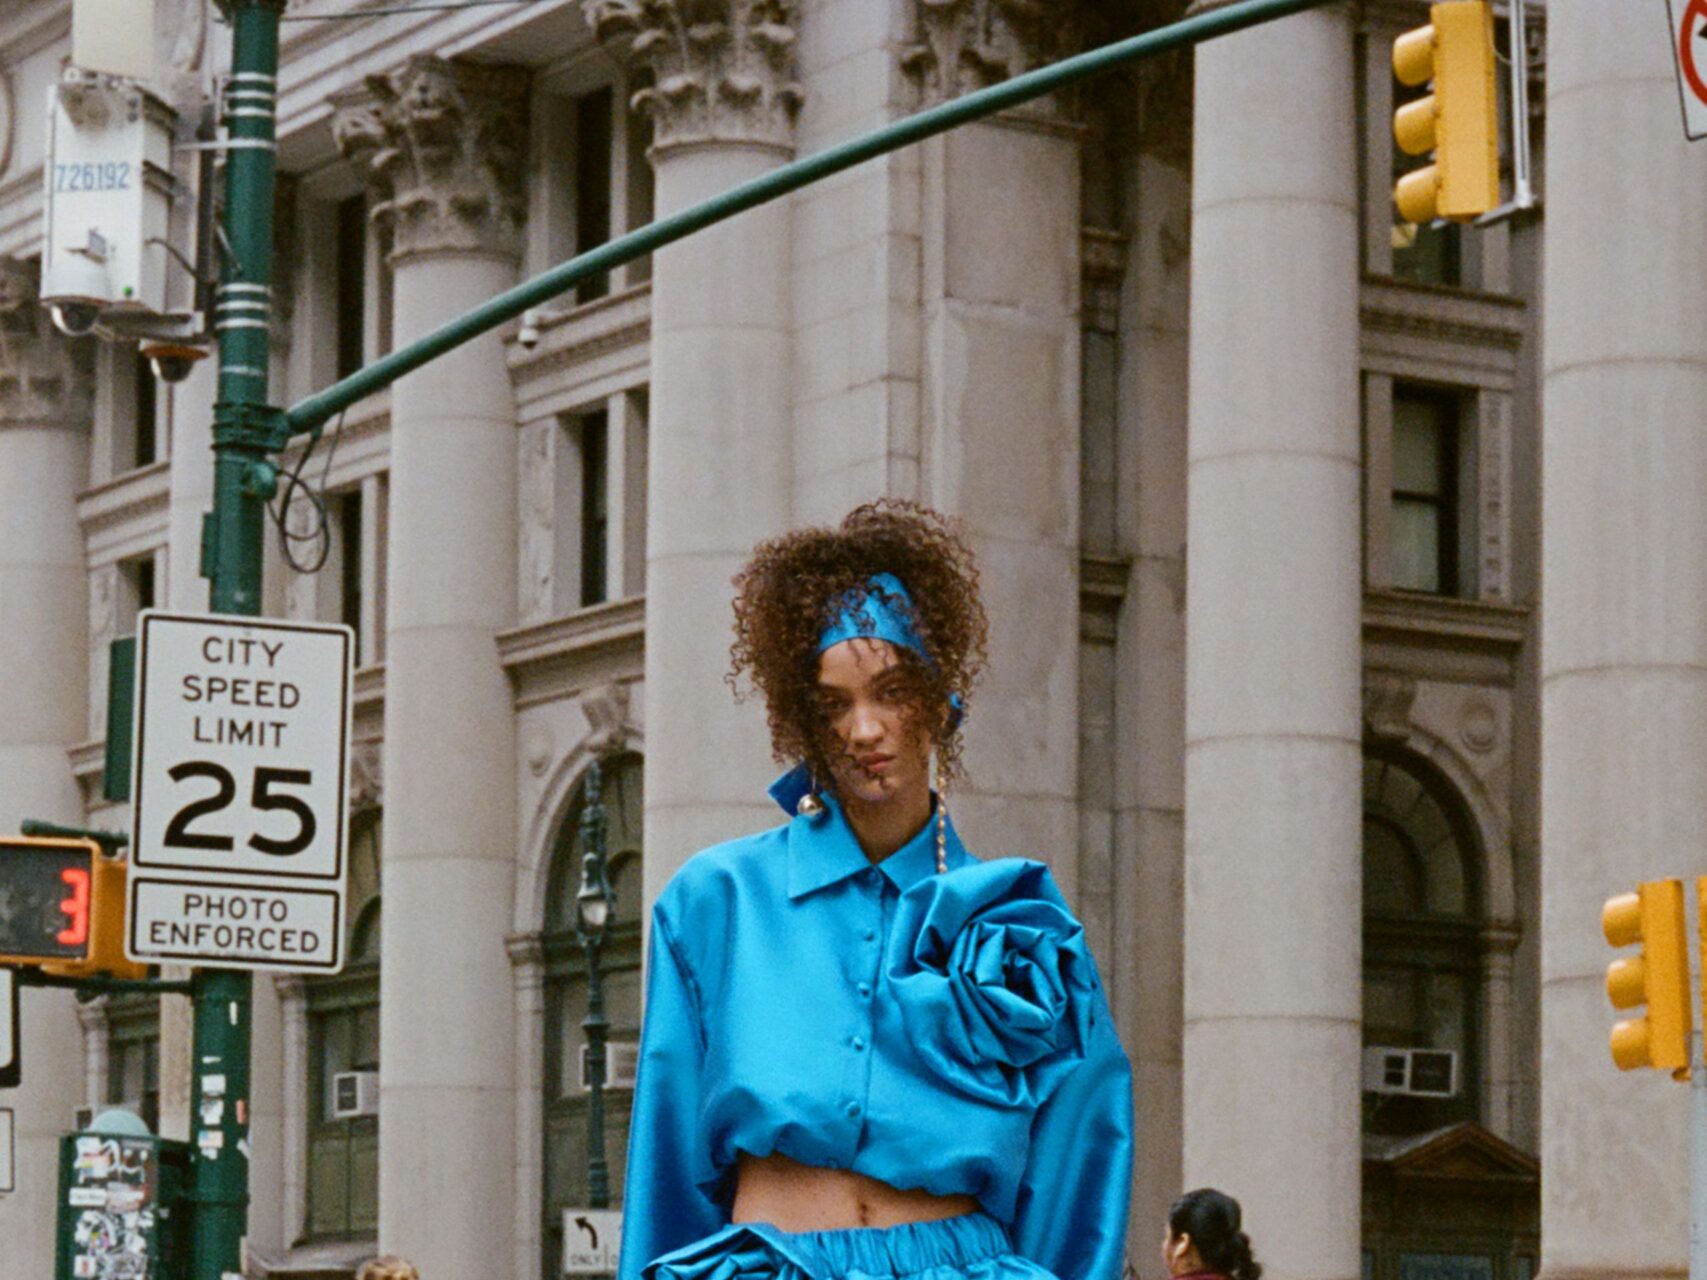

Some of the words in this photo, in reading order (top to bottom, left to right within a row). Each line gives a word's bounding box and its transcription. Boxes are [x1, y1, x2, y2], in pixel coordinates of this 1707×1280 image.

[55, 161, 131, 191] 726192
[202, 636, 284, 667] CITY
[182, 675, 300, 709] SPEED
[194, 716, 287, 747] LIMIT
[163, 760, 316, 856] 25
[57, 867, 89, 945] 3
[183, 893, 288, 922] PHOTO
[149, 921, 319, 953] ENFORCED
